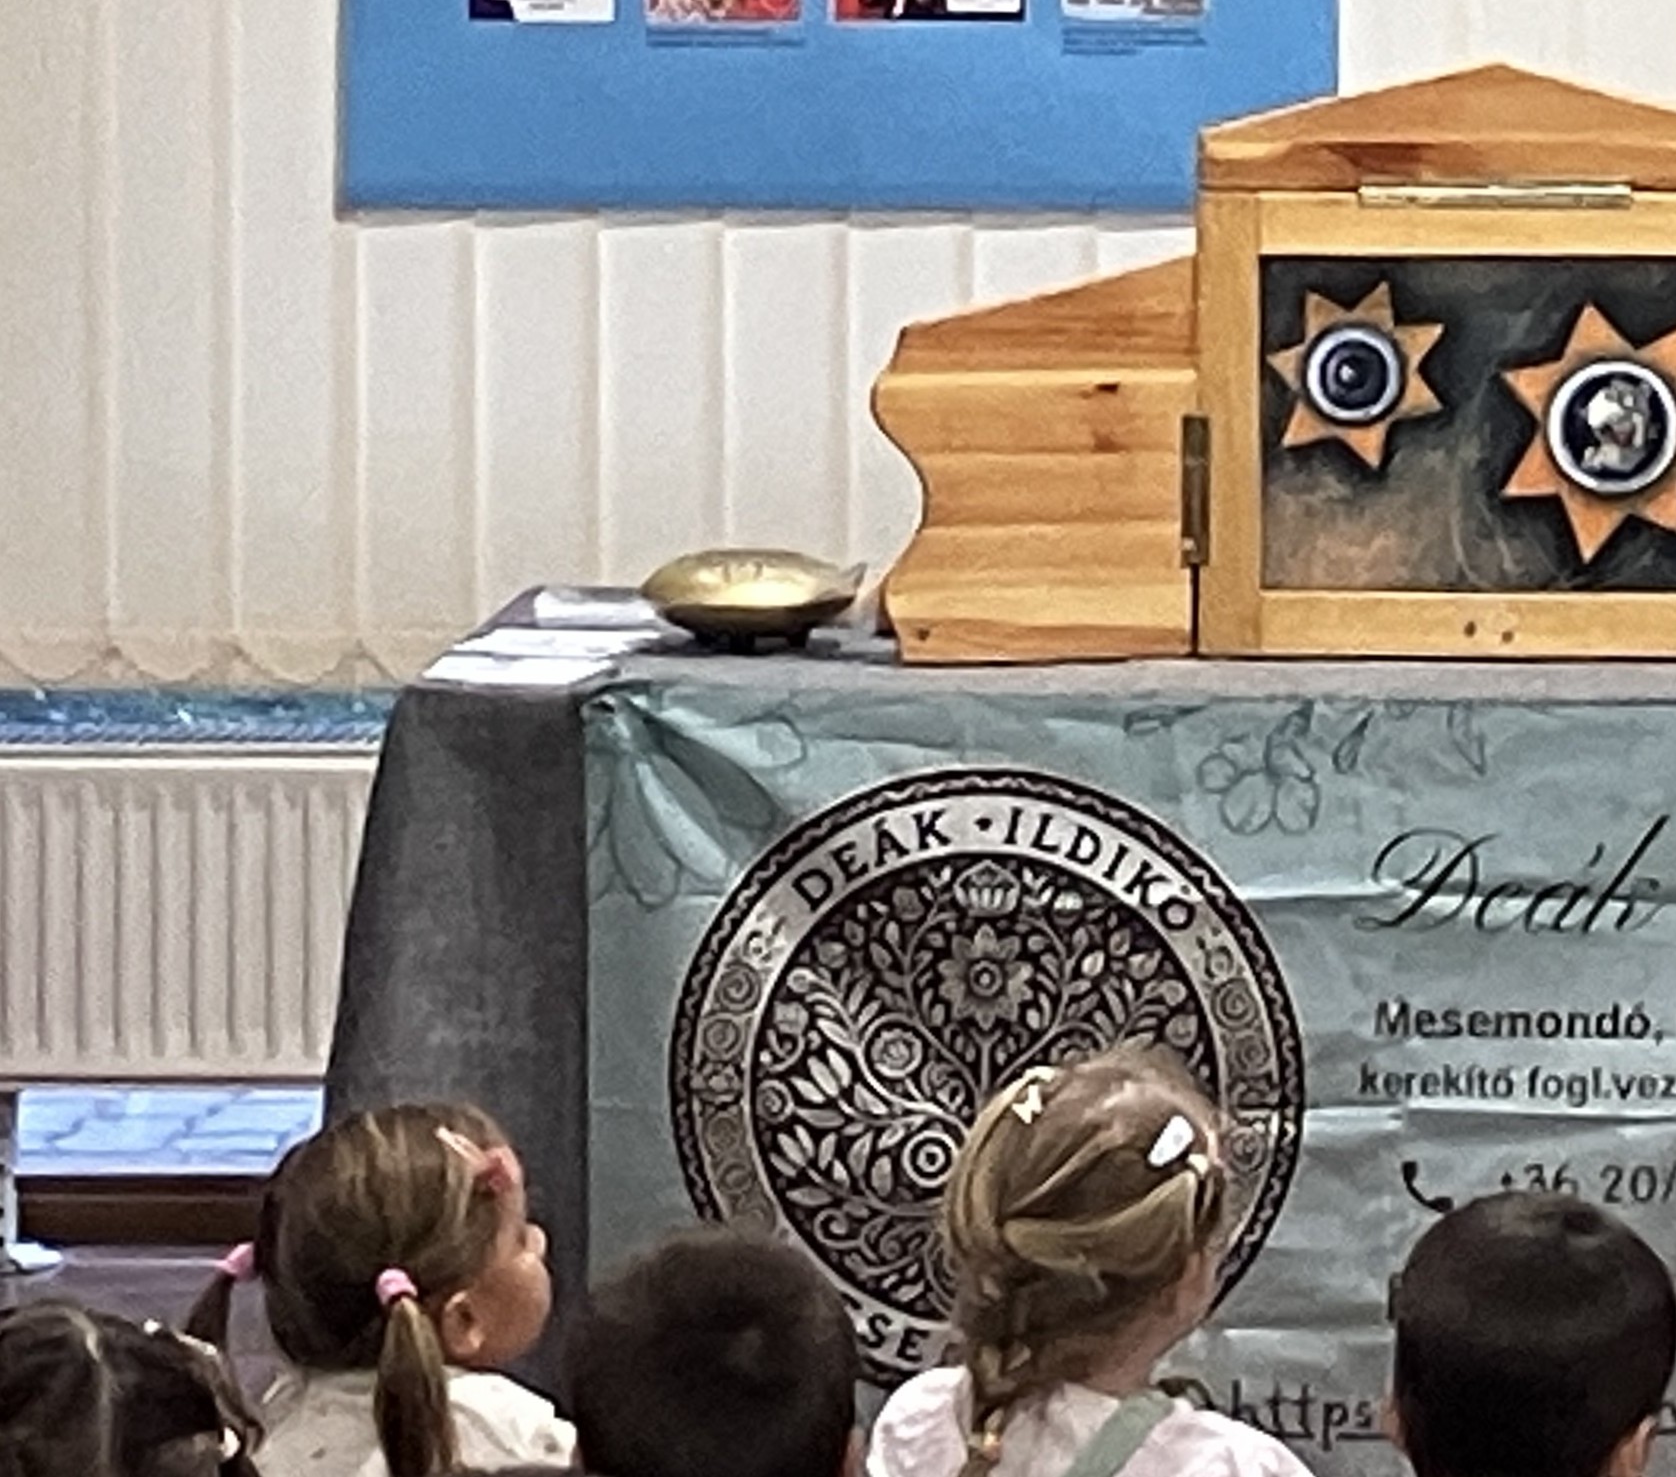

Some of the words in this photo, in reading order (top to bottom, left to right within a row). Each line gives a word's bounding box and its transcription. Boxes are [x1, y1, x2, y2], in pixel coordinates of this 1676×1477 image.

[792, 808, 951, 912] DEÁK
[1003, 807, 1197, 930] ILDIKÓ
[1352, 814, 1670, 933] Deák
[1374, 994, 1663, 1045] Mesemondó,
[1229, 1378, 1376, 1452] https
